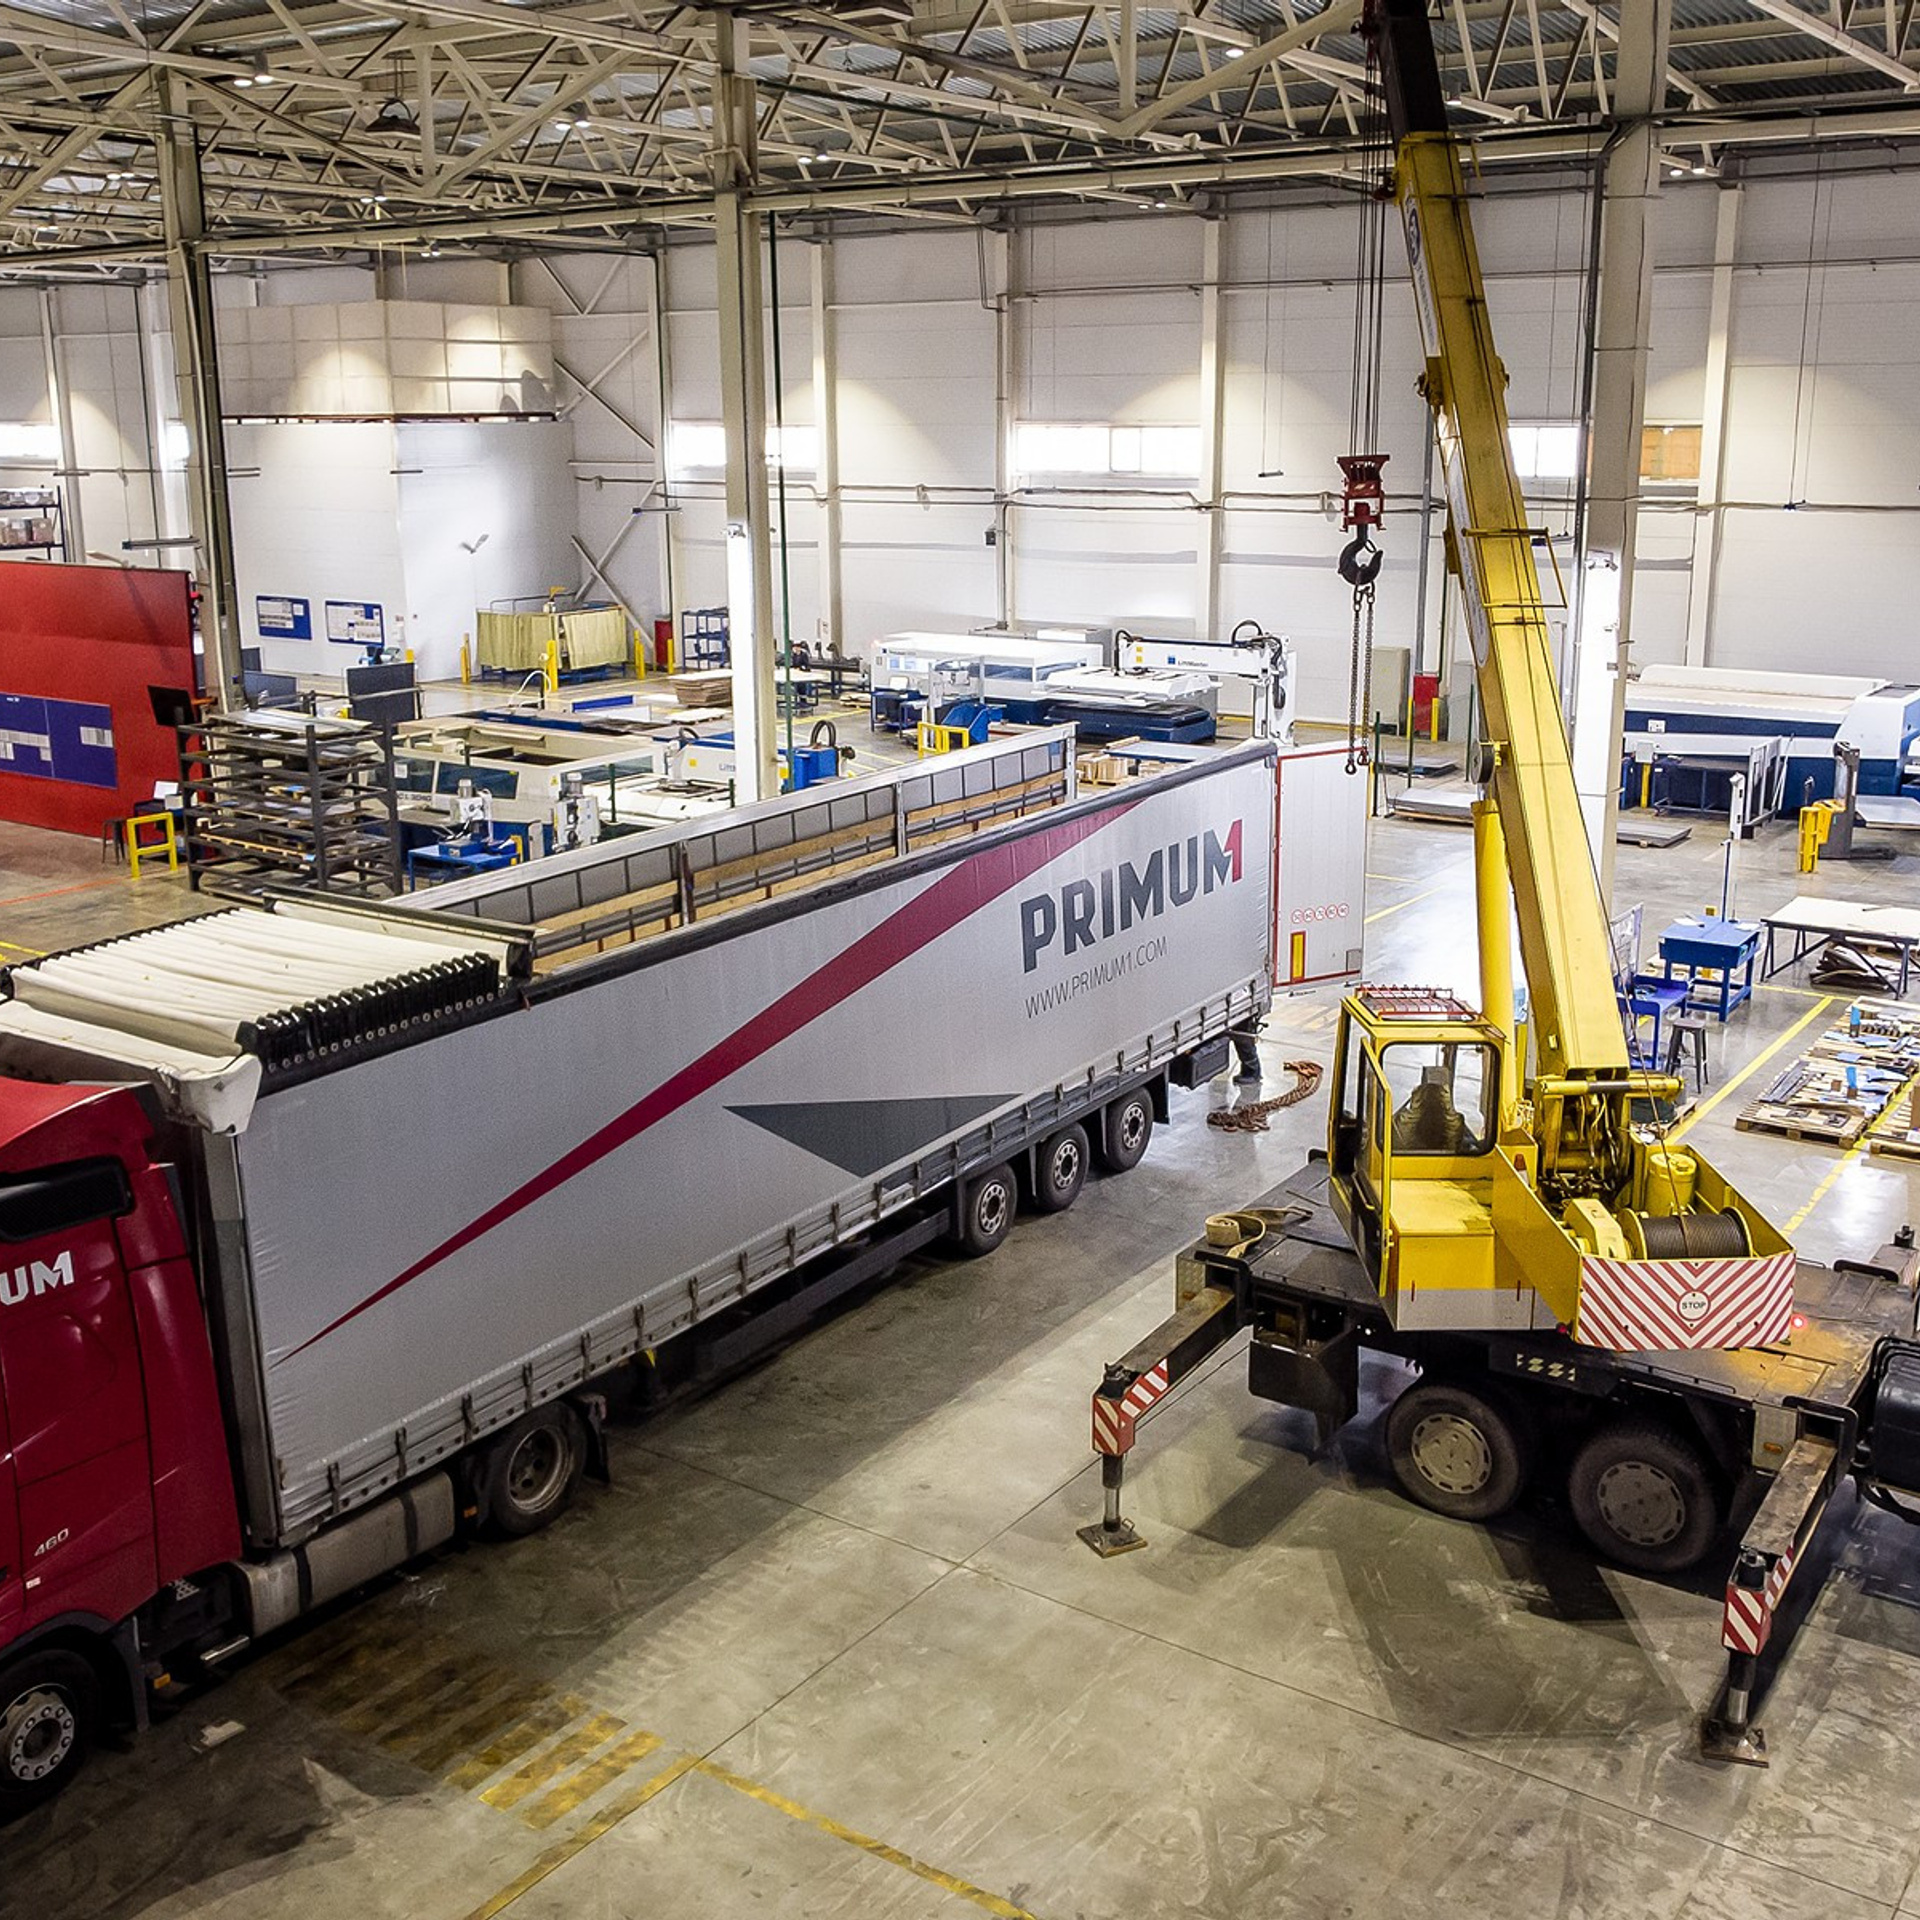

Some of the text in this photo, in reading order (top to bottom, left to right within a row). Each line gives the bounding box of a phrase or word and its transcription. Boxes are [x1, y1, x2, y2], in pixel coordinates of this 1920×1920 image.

[1025, 936, 1168, 1019] WWW.PRIMUM1.COM
[1681, 1301, 1707, 1310] STOP
[34, 1527, 70, 1557] 460
